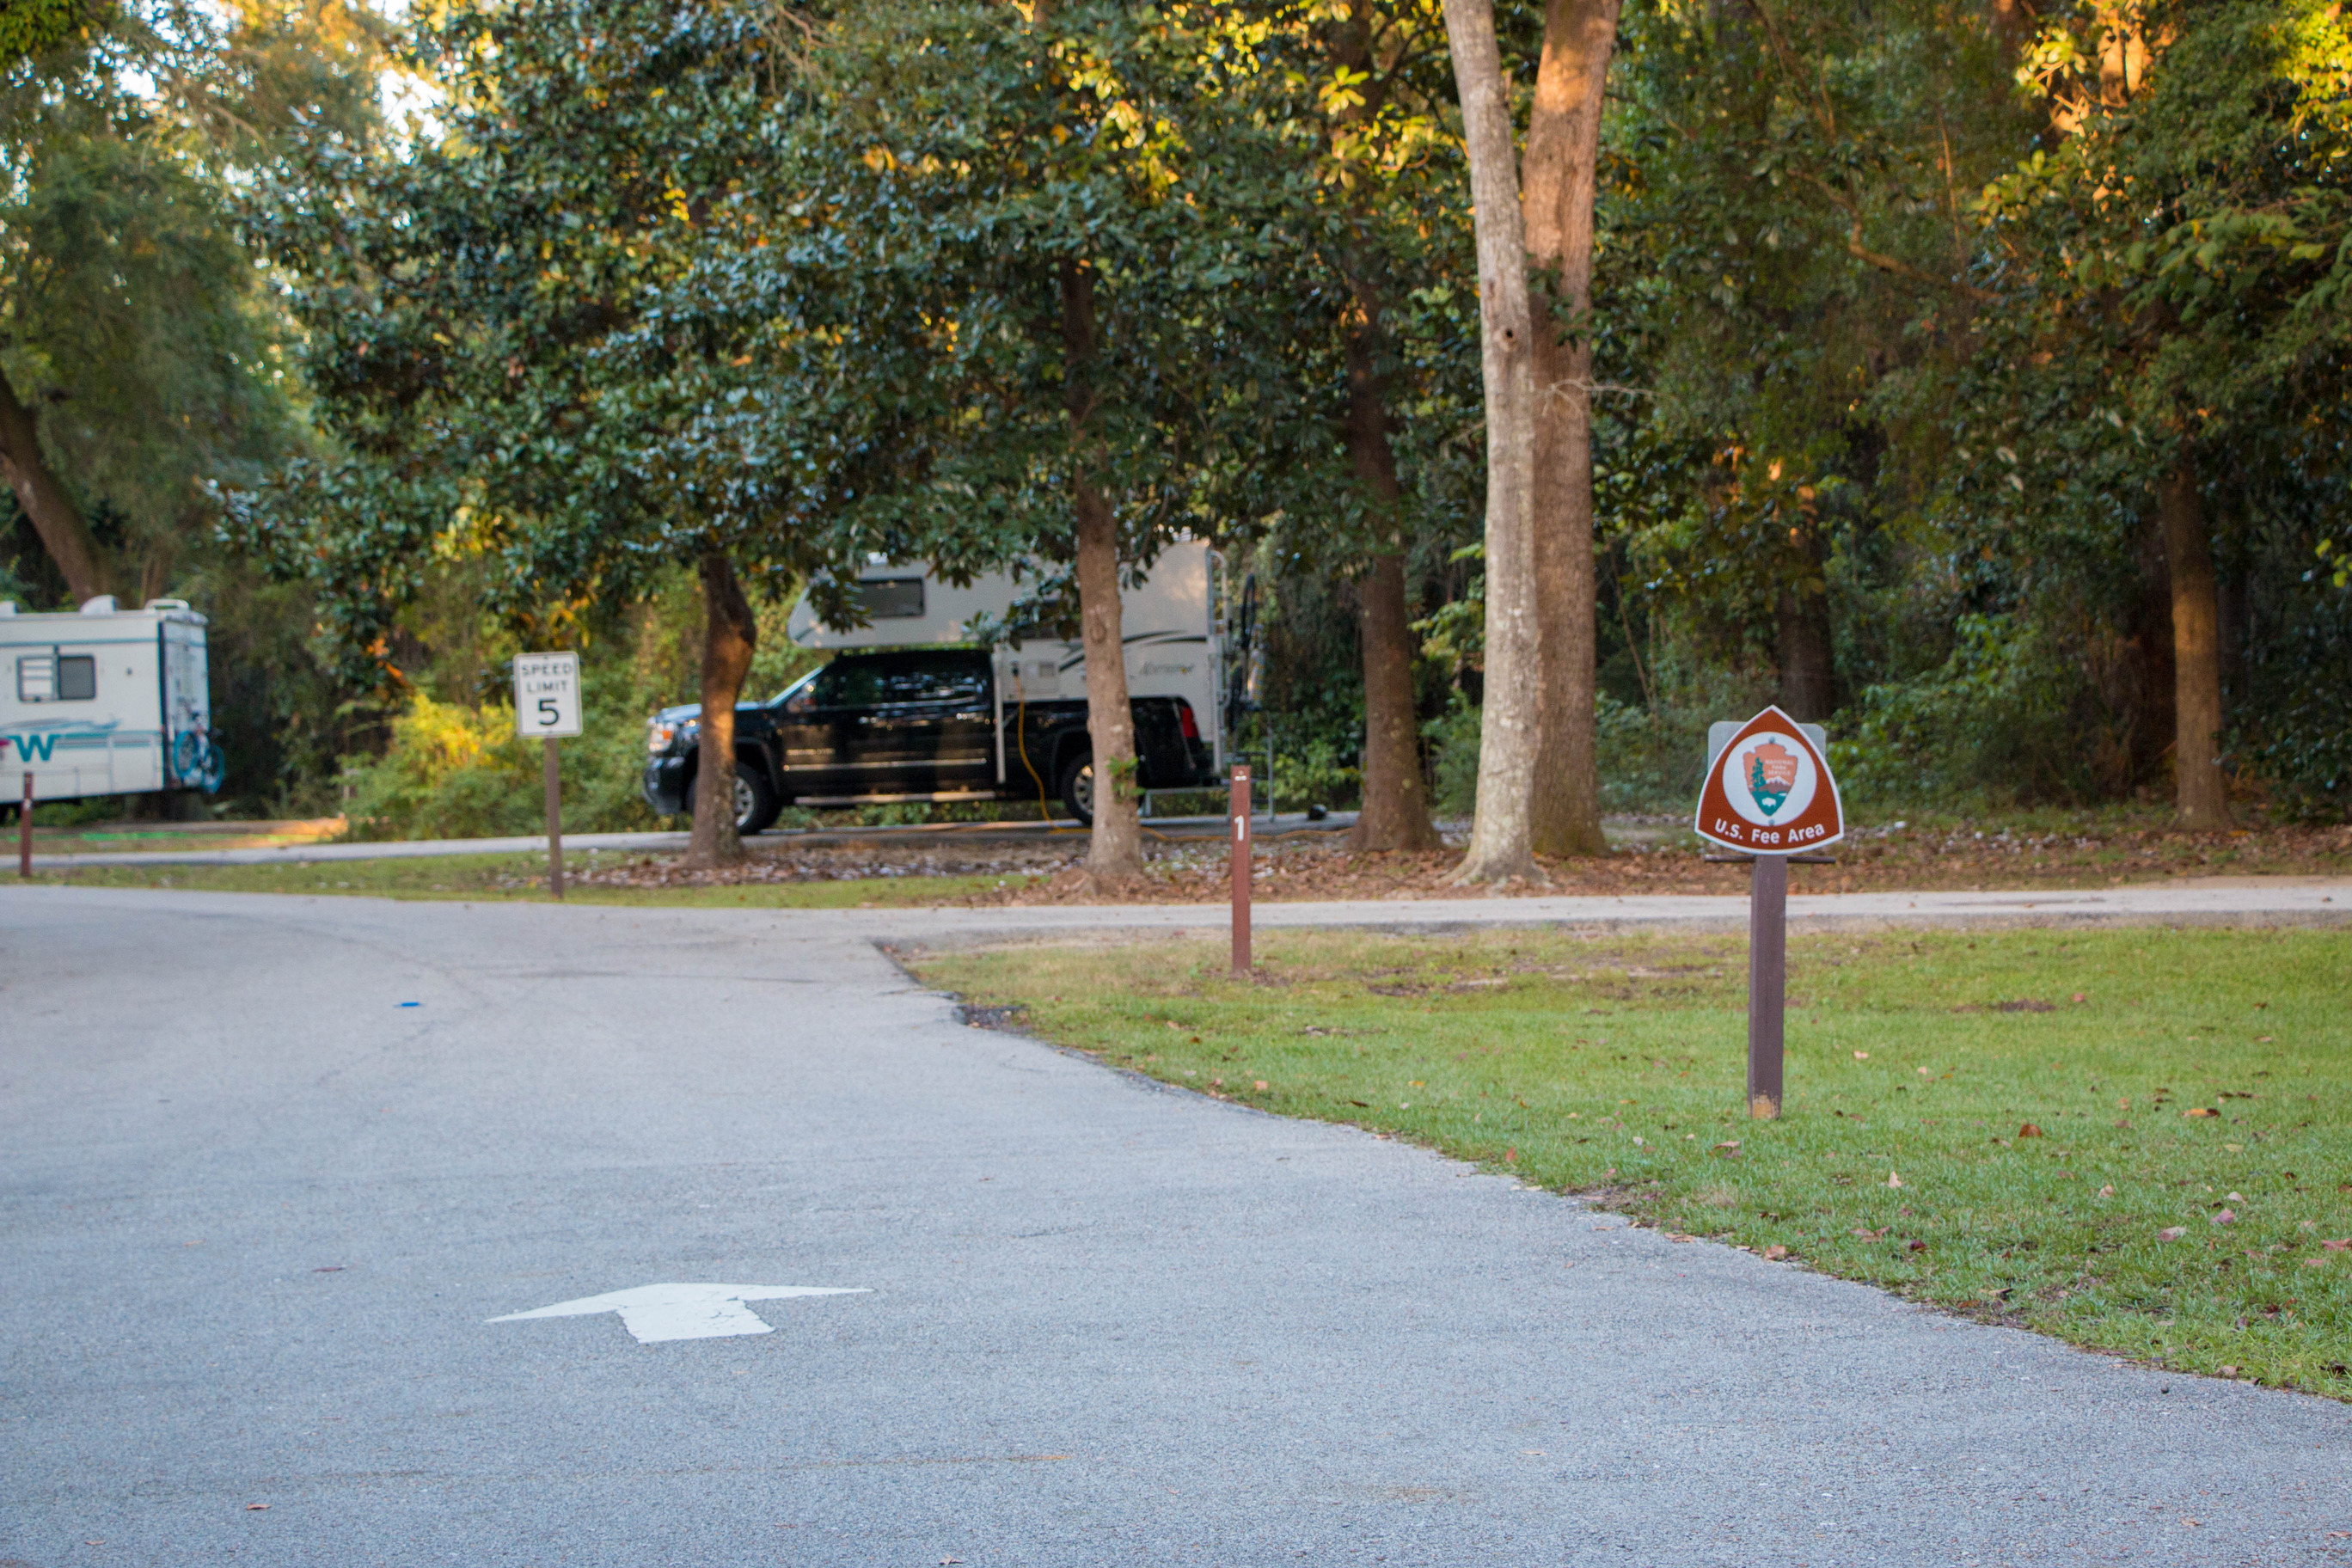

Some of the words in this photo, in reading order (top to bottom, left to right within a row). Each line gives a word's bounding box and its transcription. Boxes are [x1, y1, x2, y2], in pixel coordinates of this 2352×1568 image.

[522, 663, 573, 676] SPEED
[526, 680, 568, 693] LIMIT
[538, 698, 560, 726] 5
[1234, 814, 1245, 842] 1
[1714, 818, 1743, 840] U.S.
[1751, 829, 1780, 844] Fee
[1787, 824, 1825, 843] Area
